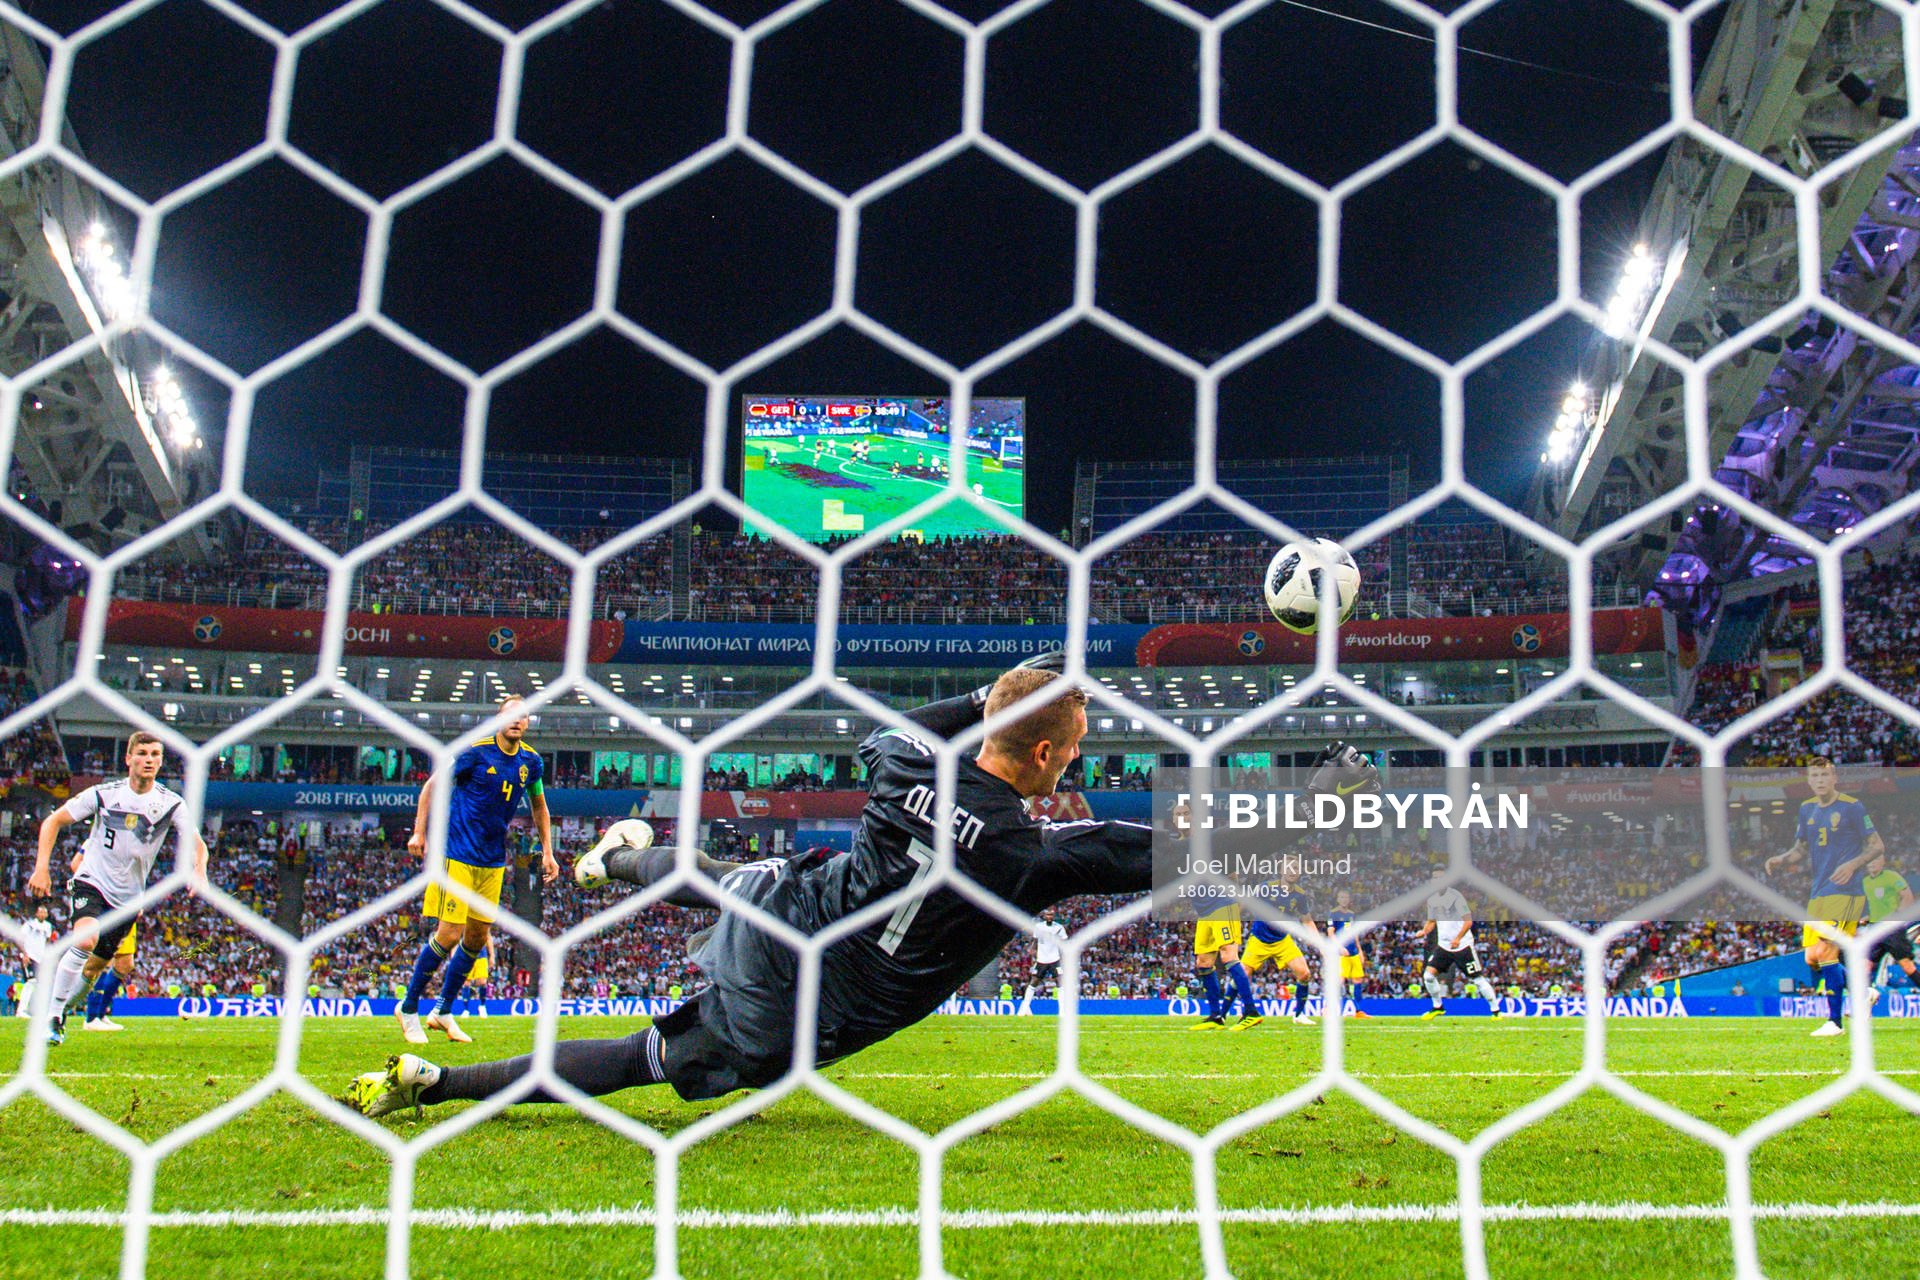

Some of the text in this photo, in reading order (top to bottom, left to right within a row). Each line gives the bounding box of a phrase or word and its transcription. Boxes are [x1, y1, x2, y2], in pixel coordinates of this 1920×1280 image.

[771, 406, 790, 414] GER
[831, 406, 851, 414] SWE
[344, 627, 390, 643] OCHI
[1345, 632, 1431, 649] #worldcup
[640, 636, 753, 651] ЧЕМПИОНАТ
[758, 637, 811, 651] МИРА
[847, 639, 930, 653] ФУТБОЛУ
[936, 640, 973, 653] FIFA
[977, 640, 1017, 653] 2018
[1039, 640, 1112, 653] РОИИ
[502, 780, 513, 801] 4
[295, 791, 419, 807] 2018 FIFA WORL
[104, 827, 116, 850] 9
[1817, 826, 1827, 846] 3
[1221, 926, 1231, 941] 8
[607, 1000, 686, 1016] WAND
